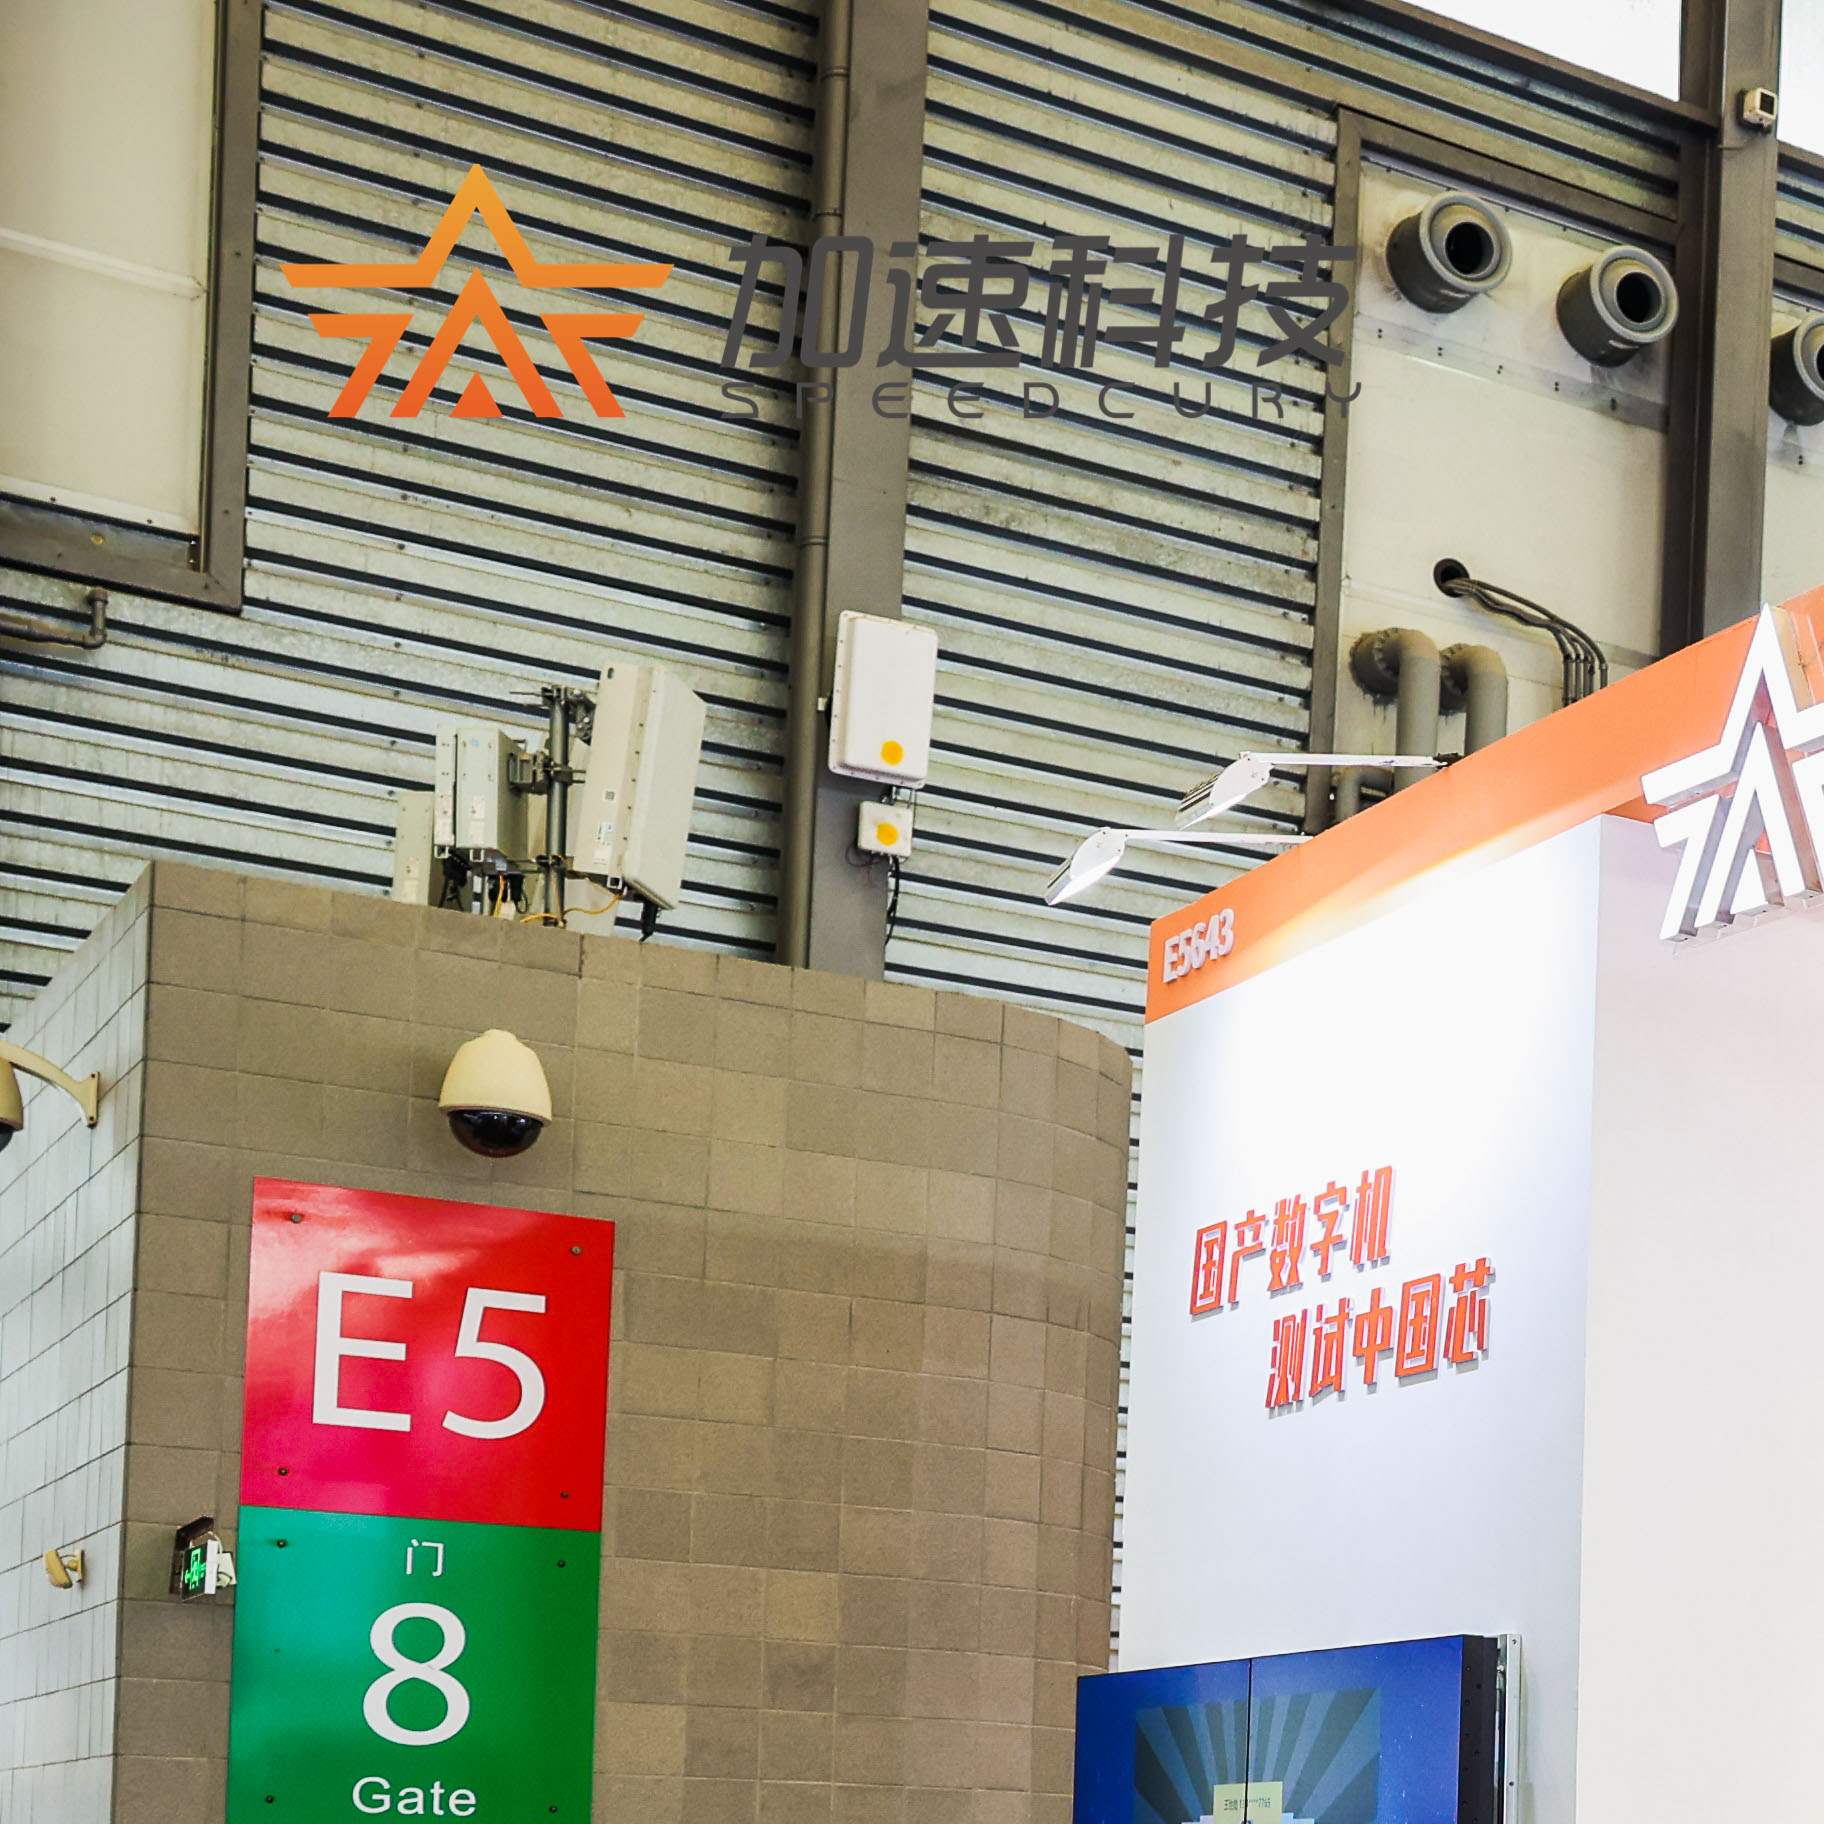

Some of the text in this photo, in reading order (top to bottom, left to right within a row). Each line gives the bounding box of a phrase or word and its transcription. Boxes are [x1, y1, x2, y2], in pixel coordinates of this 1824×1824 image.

[1162, 907, 1235, 983] E5643
[1189, 1165, 1396, 1316] 国产数字机
[312, 1270, 547, 1440] E5
[1264, 1257, 1496, 1410] 测试中国芯
[405, 1539, 444, 1577] 门
[363, 1602, 471, 1746] 8
[352, 1776, 478, 1817] Gate
